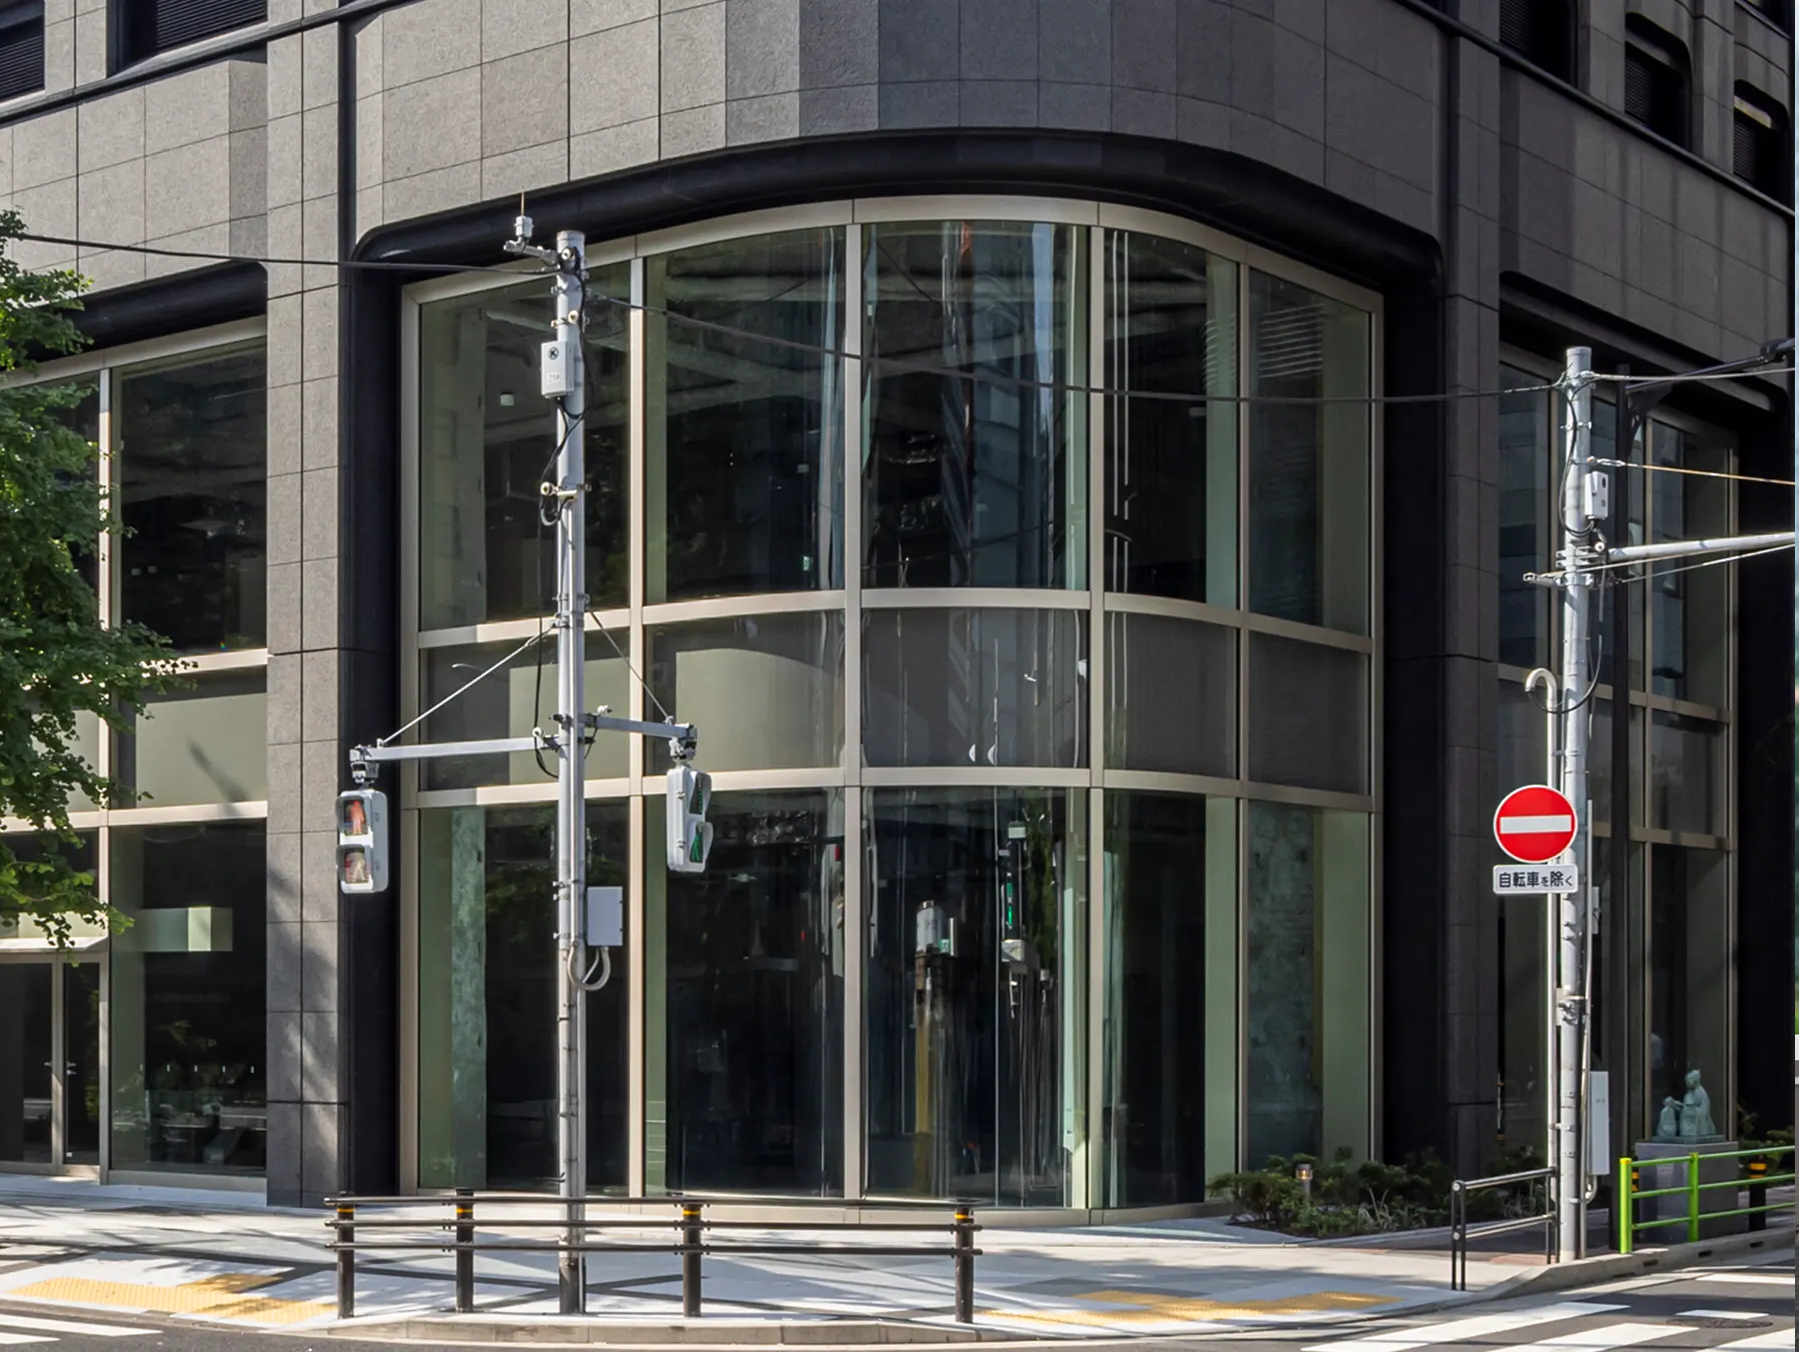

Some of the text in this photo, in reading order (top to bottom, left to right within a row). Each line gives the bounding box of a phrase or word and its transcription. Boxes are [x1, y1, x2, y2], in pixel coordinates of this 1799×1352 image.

[1499, 871, 1573, 887] 自転車を除く
